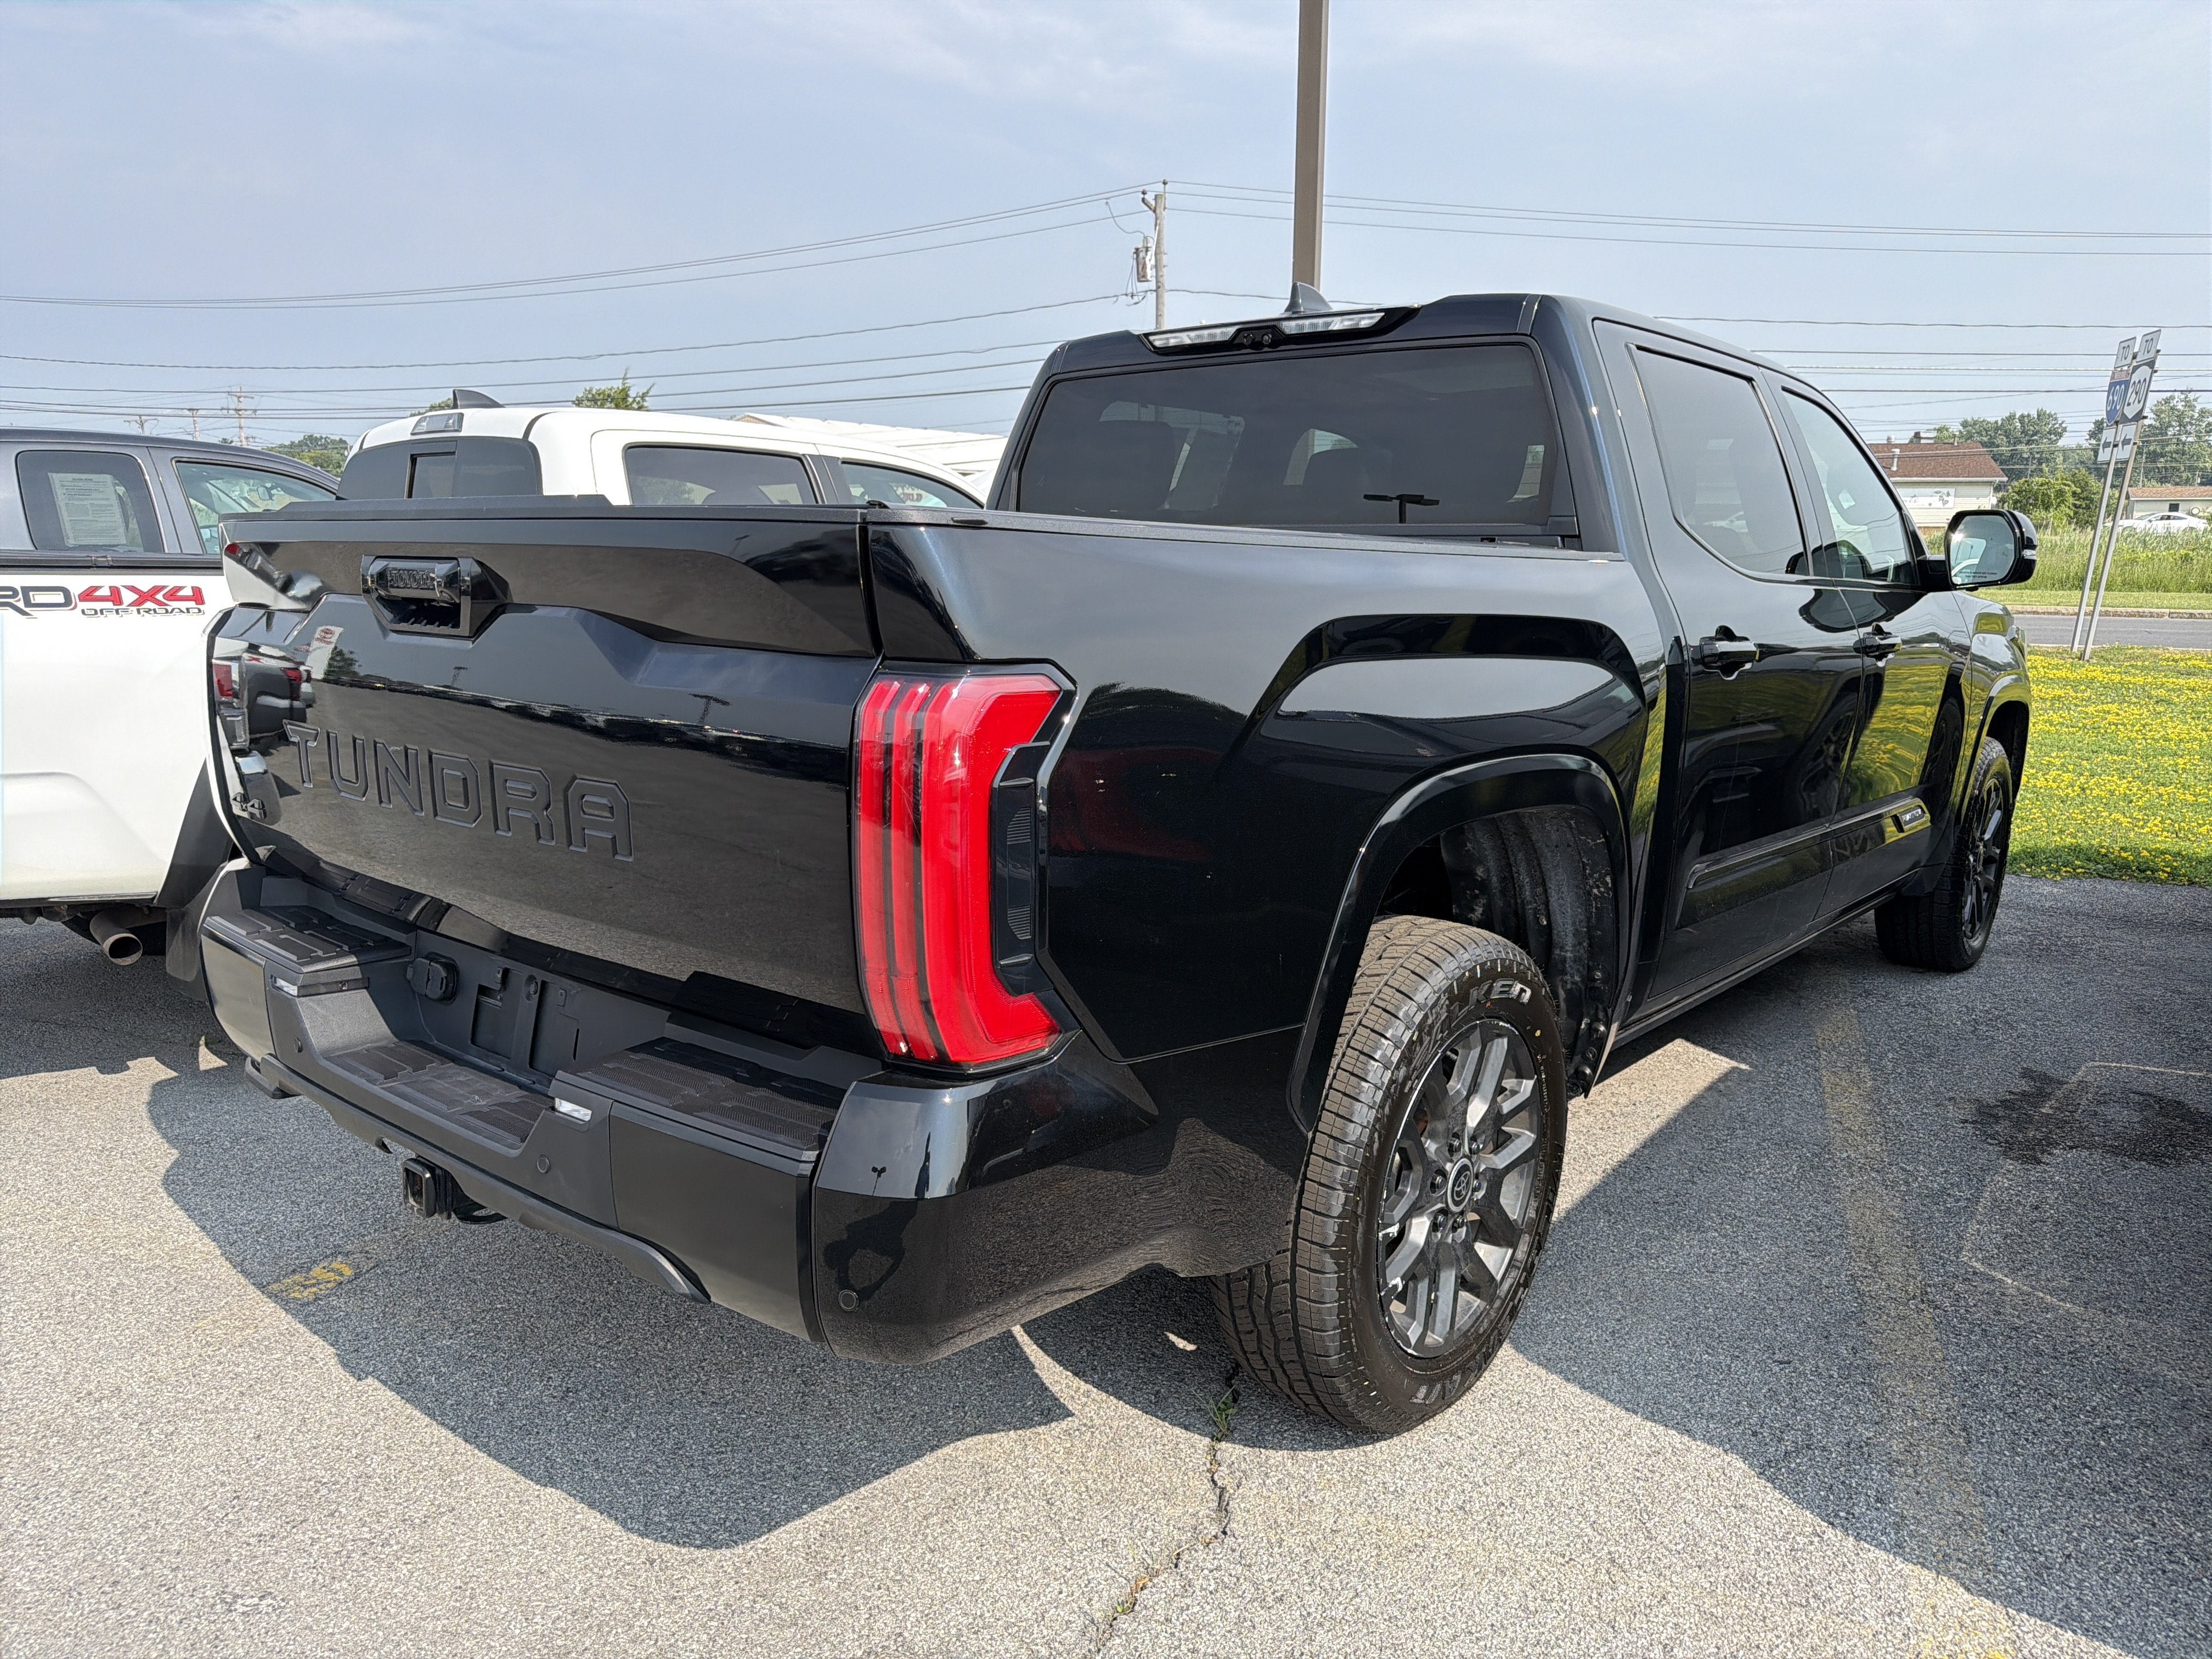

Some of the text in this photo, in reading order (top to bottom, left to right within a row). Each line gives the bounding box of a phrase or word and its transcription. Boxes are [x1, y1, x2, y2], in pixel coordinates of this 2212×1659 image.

[2121, 345, 2130, 361] TO
[2143, 338, 2154, 355] TO
[2107, 385, 2124, 411] 690
[2127, 377, 2147, 407] 290
[389, 568, 433, 589] TOYOTA
[81, 607, 205, 618] OFF ROAD
[283, 719, 634, 862] TUNDRA
